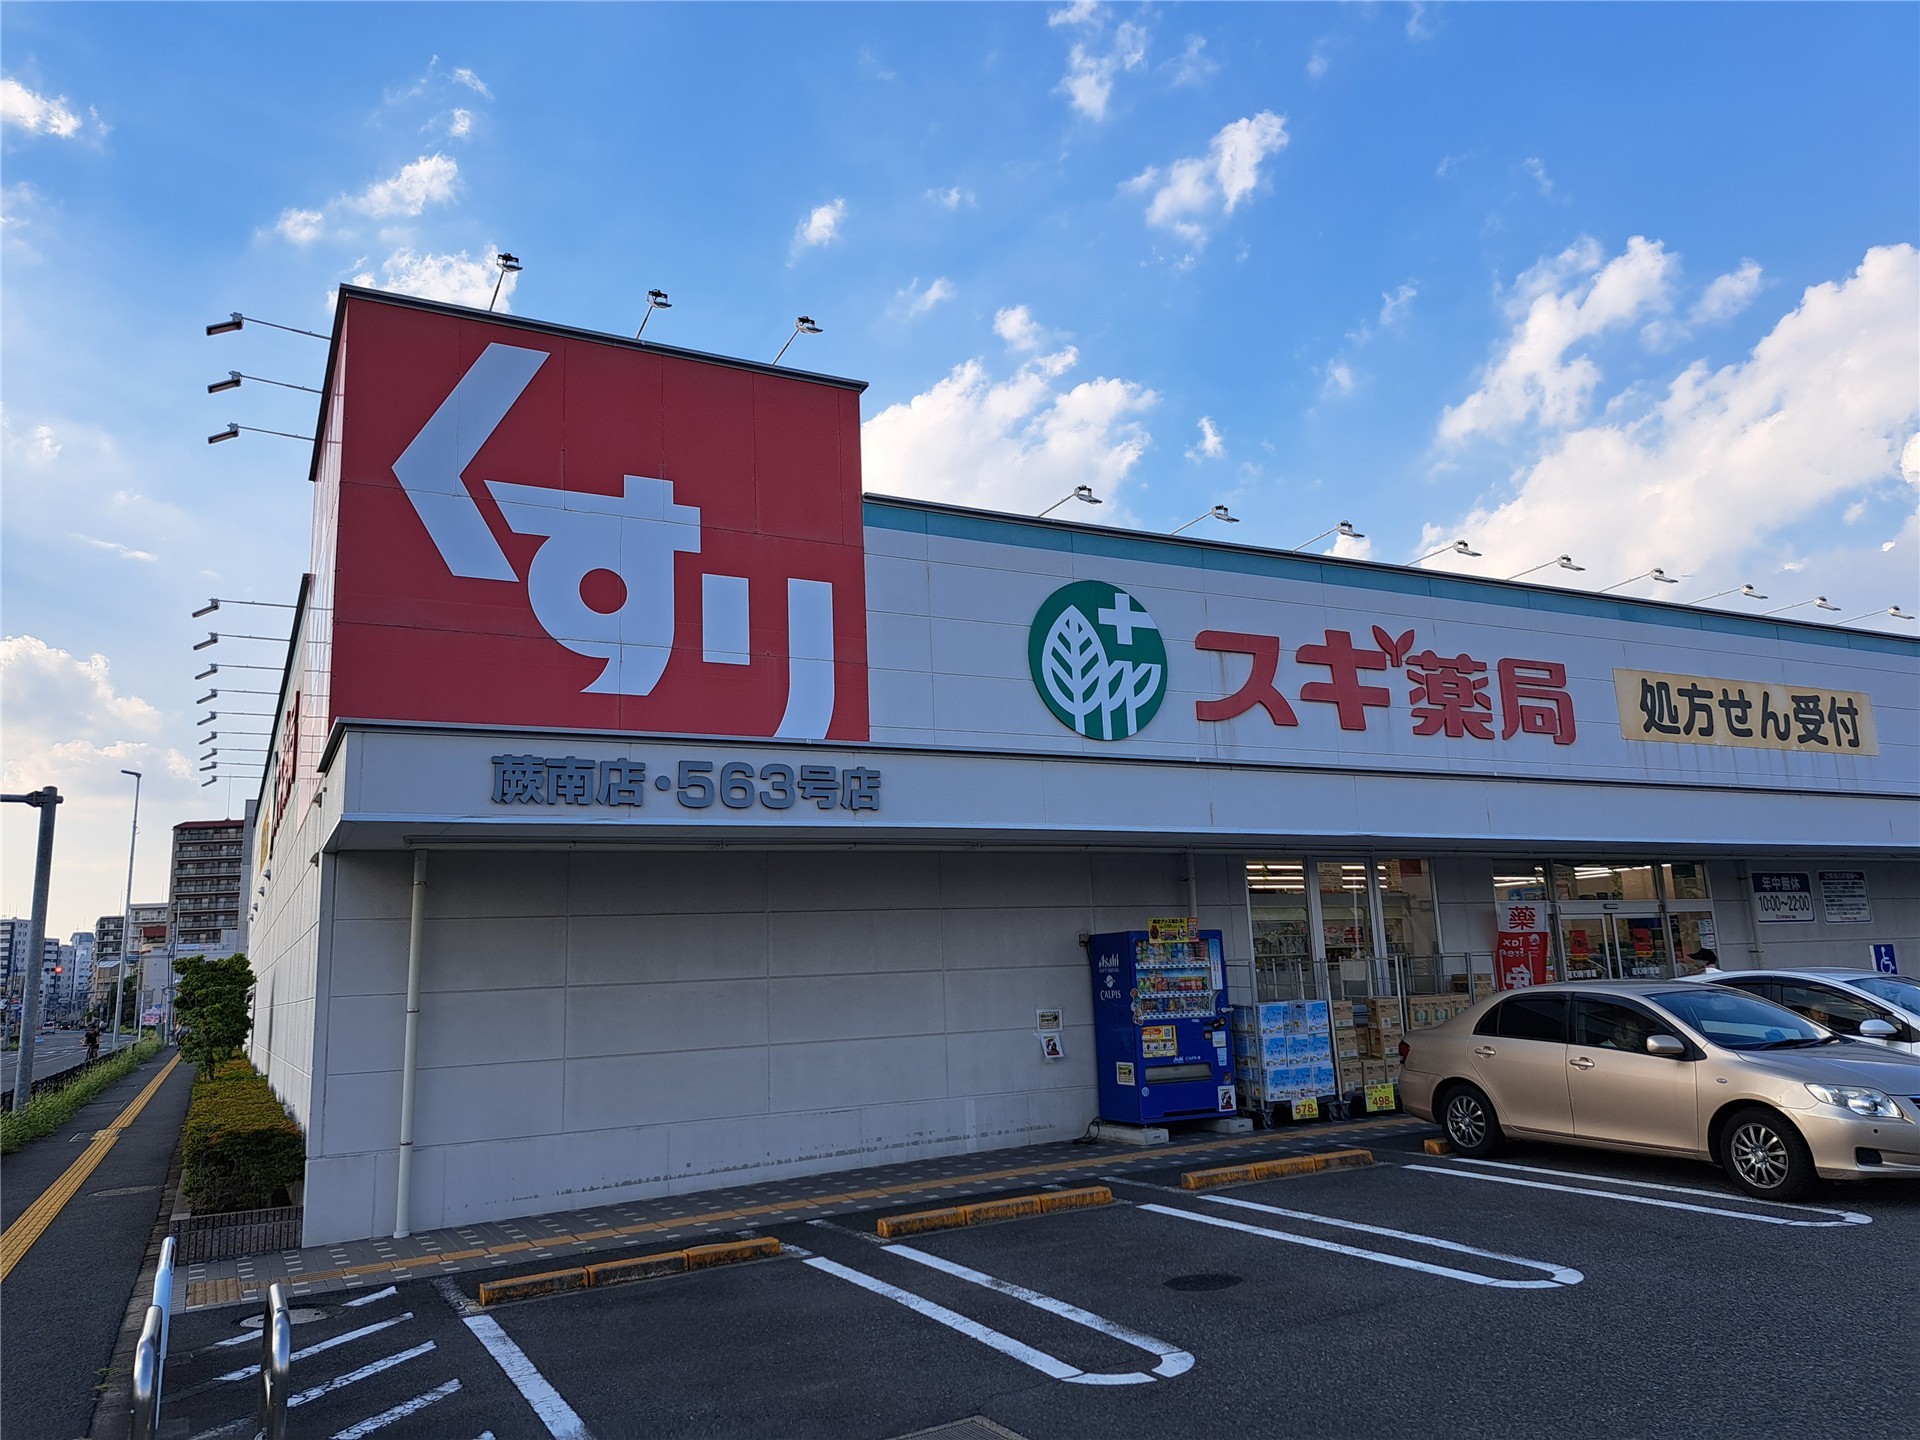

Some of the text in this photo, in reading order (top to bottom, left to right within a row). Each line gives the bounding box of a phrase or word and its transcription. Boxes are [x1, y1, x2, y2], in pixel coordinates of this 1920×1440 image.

[391, 341, 835, 740] くすり
[1195, 625, 1577, 746] スギ薬局
[1639, 676, 1861, 750] 処方せん受付
[1762, 875, 1801, 891] 年中無休
[1098, 953, 1119, 968] Asahi
[1100, 990, 1121, 1001] CALPIS
